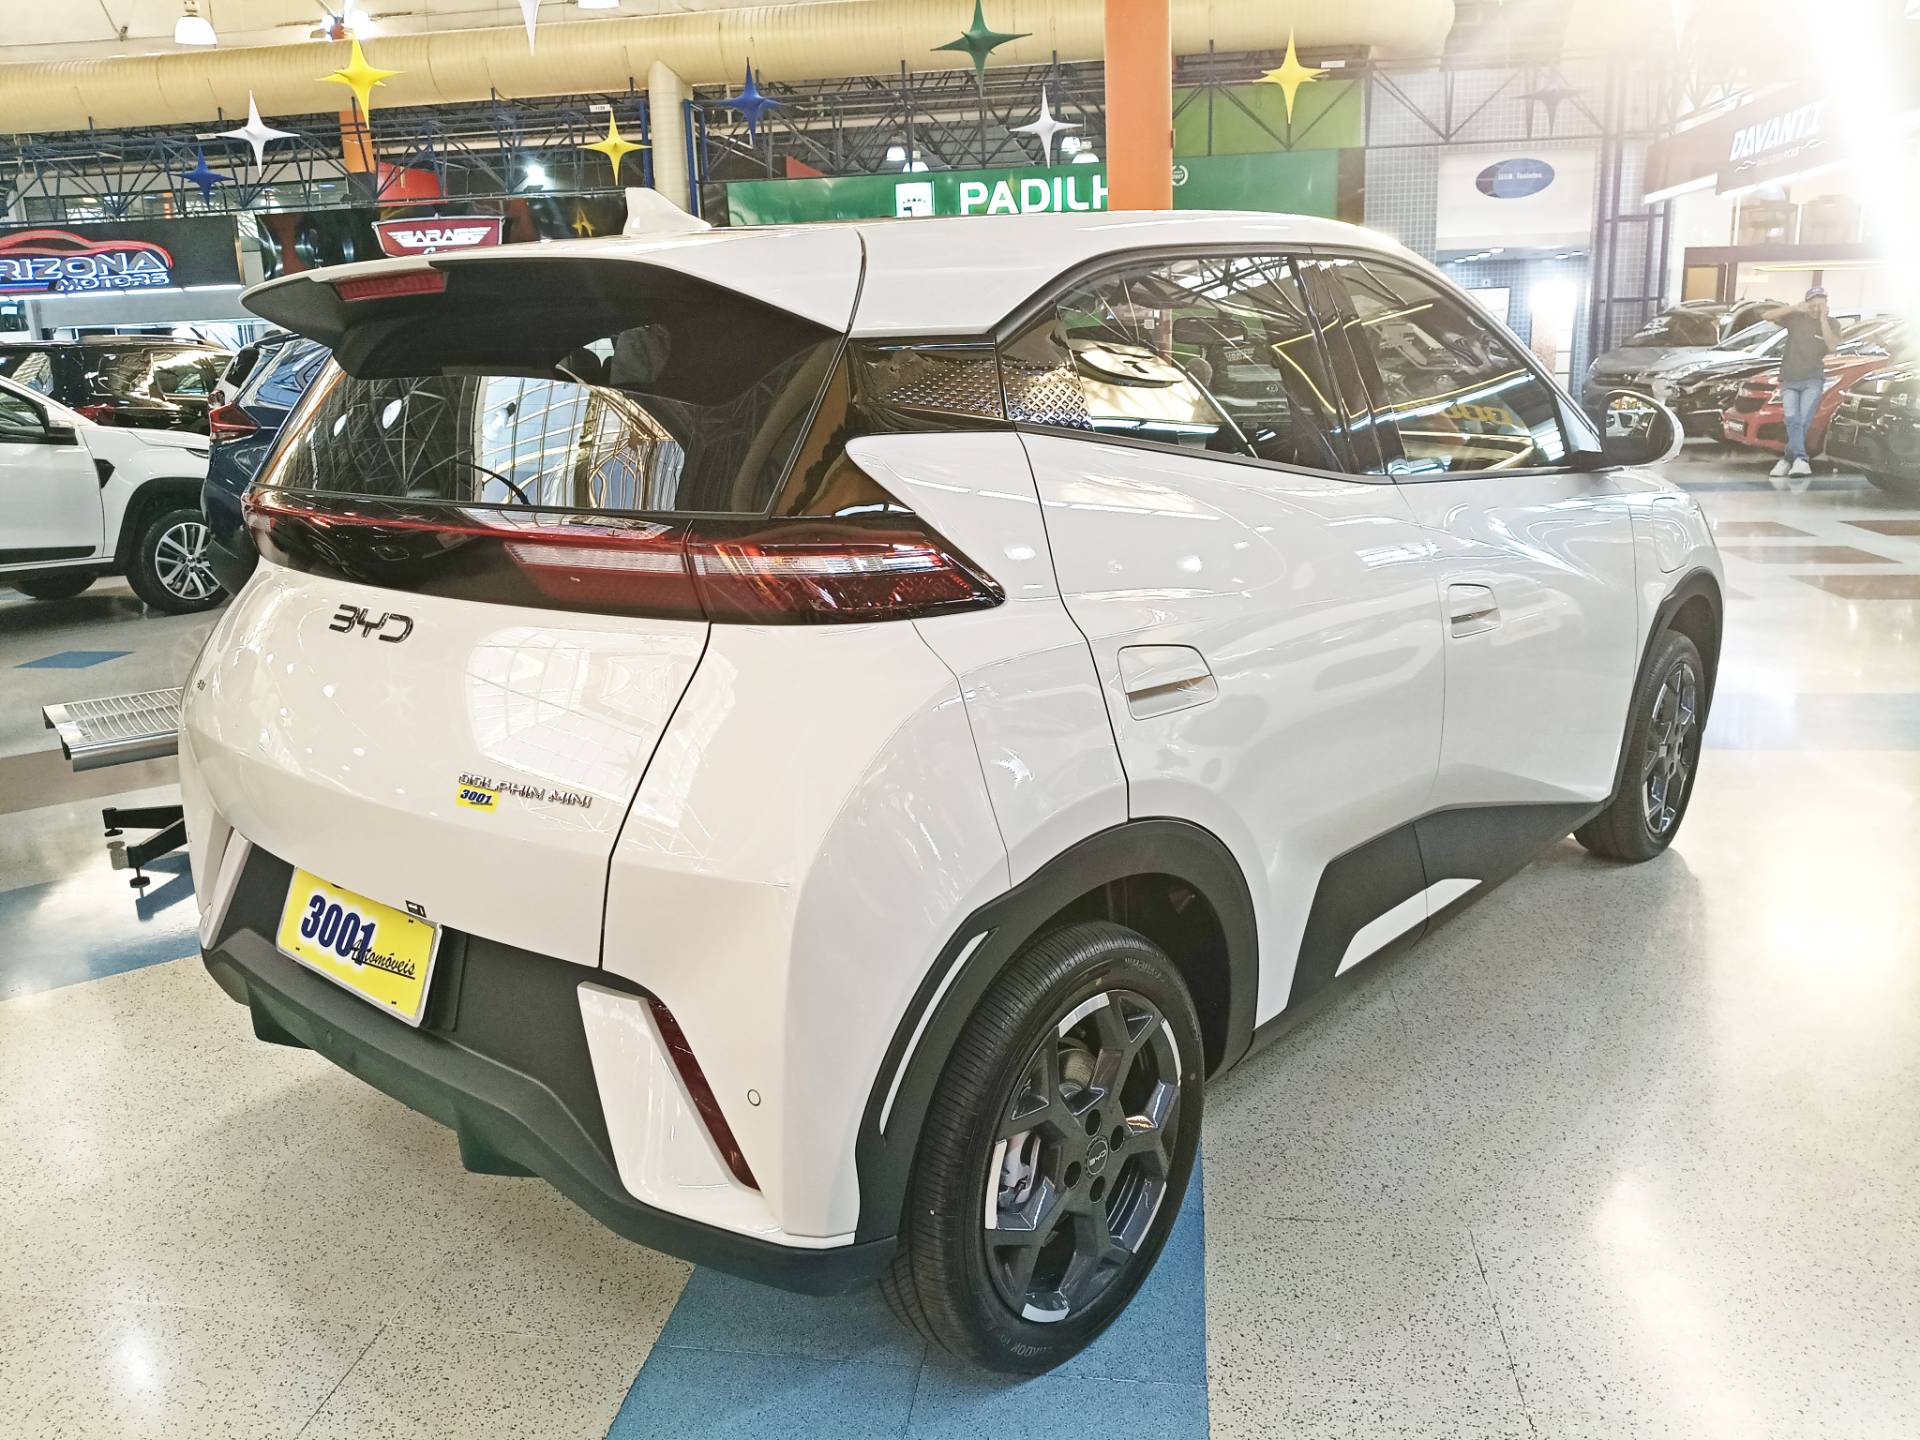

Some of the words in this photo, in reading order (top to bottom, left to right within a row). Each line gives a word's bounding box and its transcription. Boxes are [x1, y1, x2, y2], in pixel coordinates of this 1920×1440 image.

[55, 273, 170, 291] MOTORS
[329, 604, 414, 643] BYD
[458, 772, 546, 800] DOLPHIN
[549, 790, 593, 808] MINI
[460, 789, 492, 804] 3001
[301, 895, 376, 966] 3001
